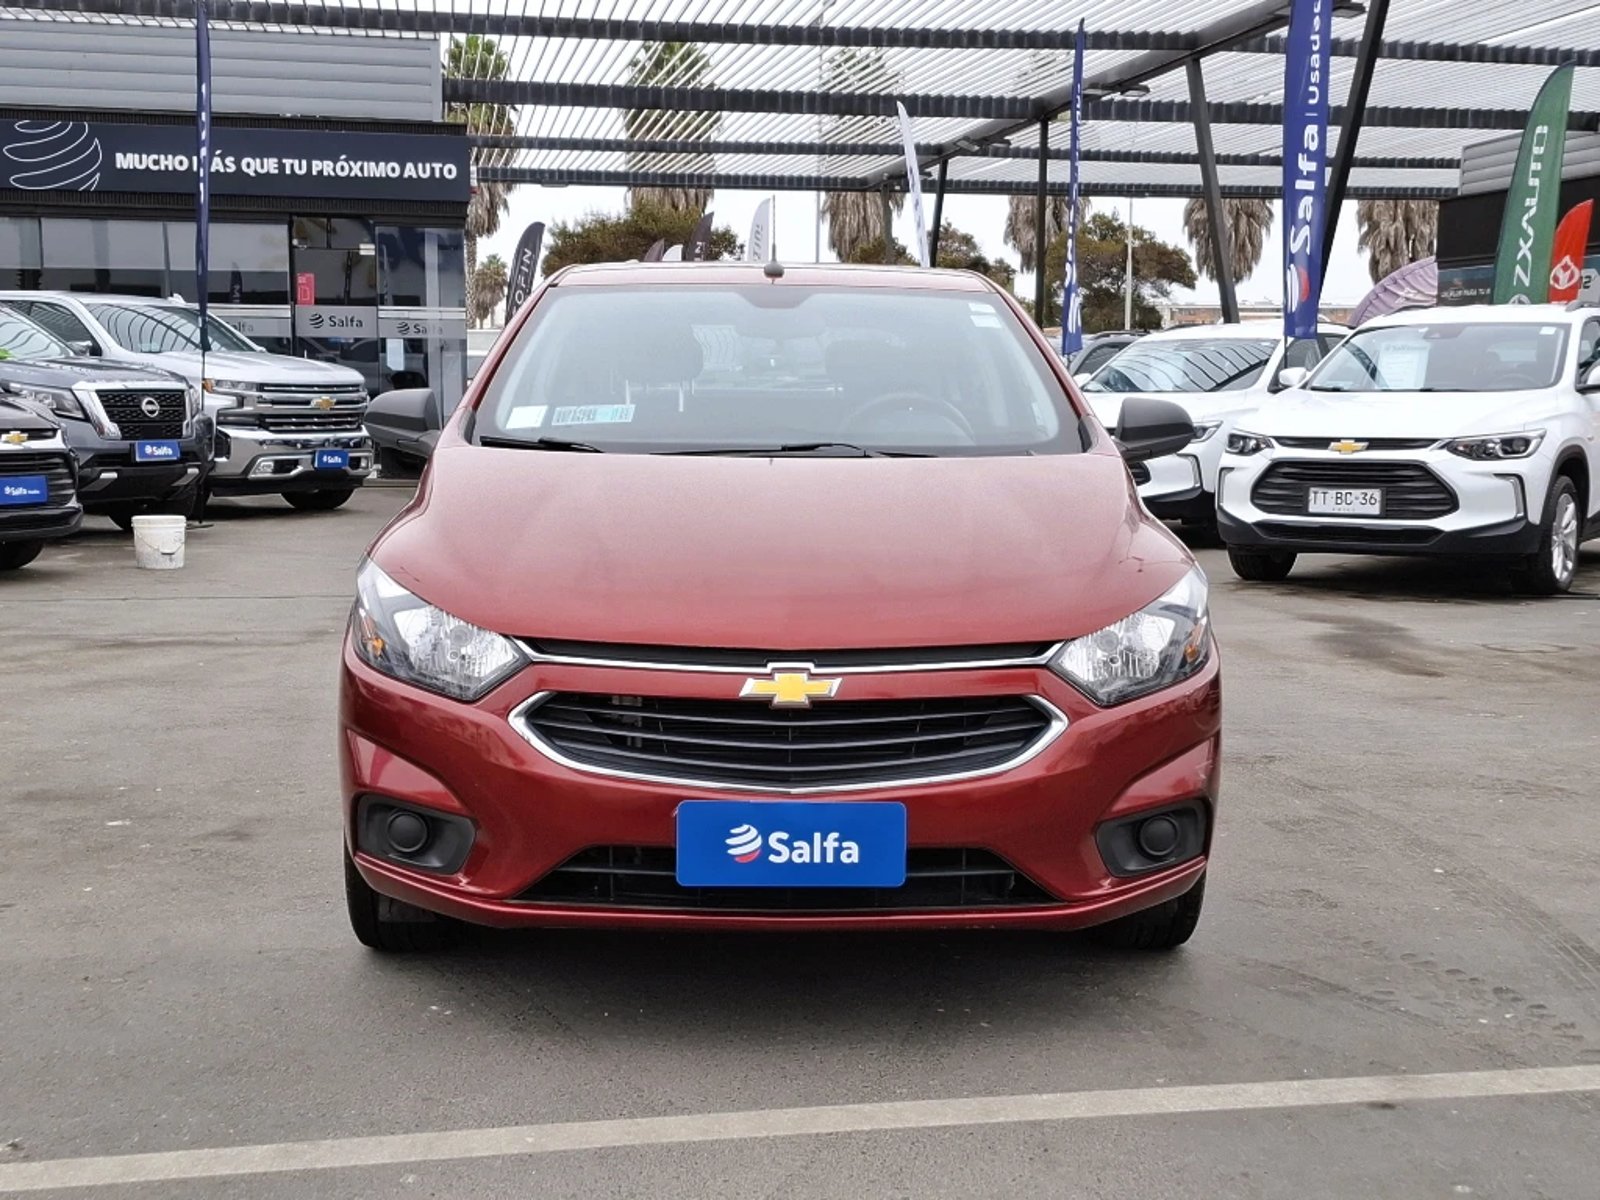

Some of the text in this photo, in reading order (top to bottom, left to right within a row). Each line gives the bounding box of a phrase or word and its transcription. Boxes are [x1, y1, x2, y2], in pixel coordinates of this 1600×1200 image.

[115, 150, 458, 179] MUCHO ÁS QUE TU PRÓXIMO AUTO
[1290, 123, 1319, 255] Salfa
[1513, 125, 1549, 287] ZXAUTO
[328, 314, 364, 328] Salfa
[768, 831, 860, 864] Salfa
